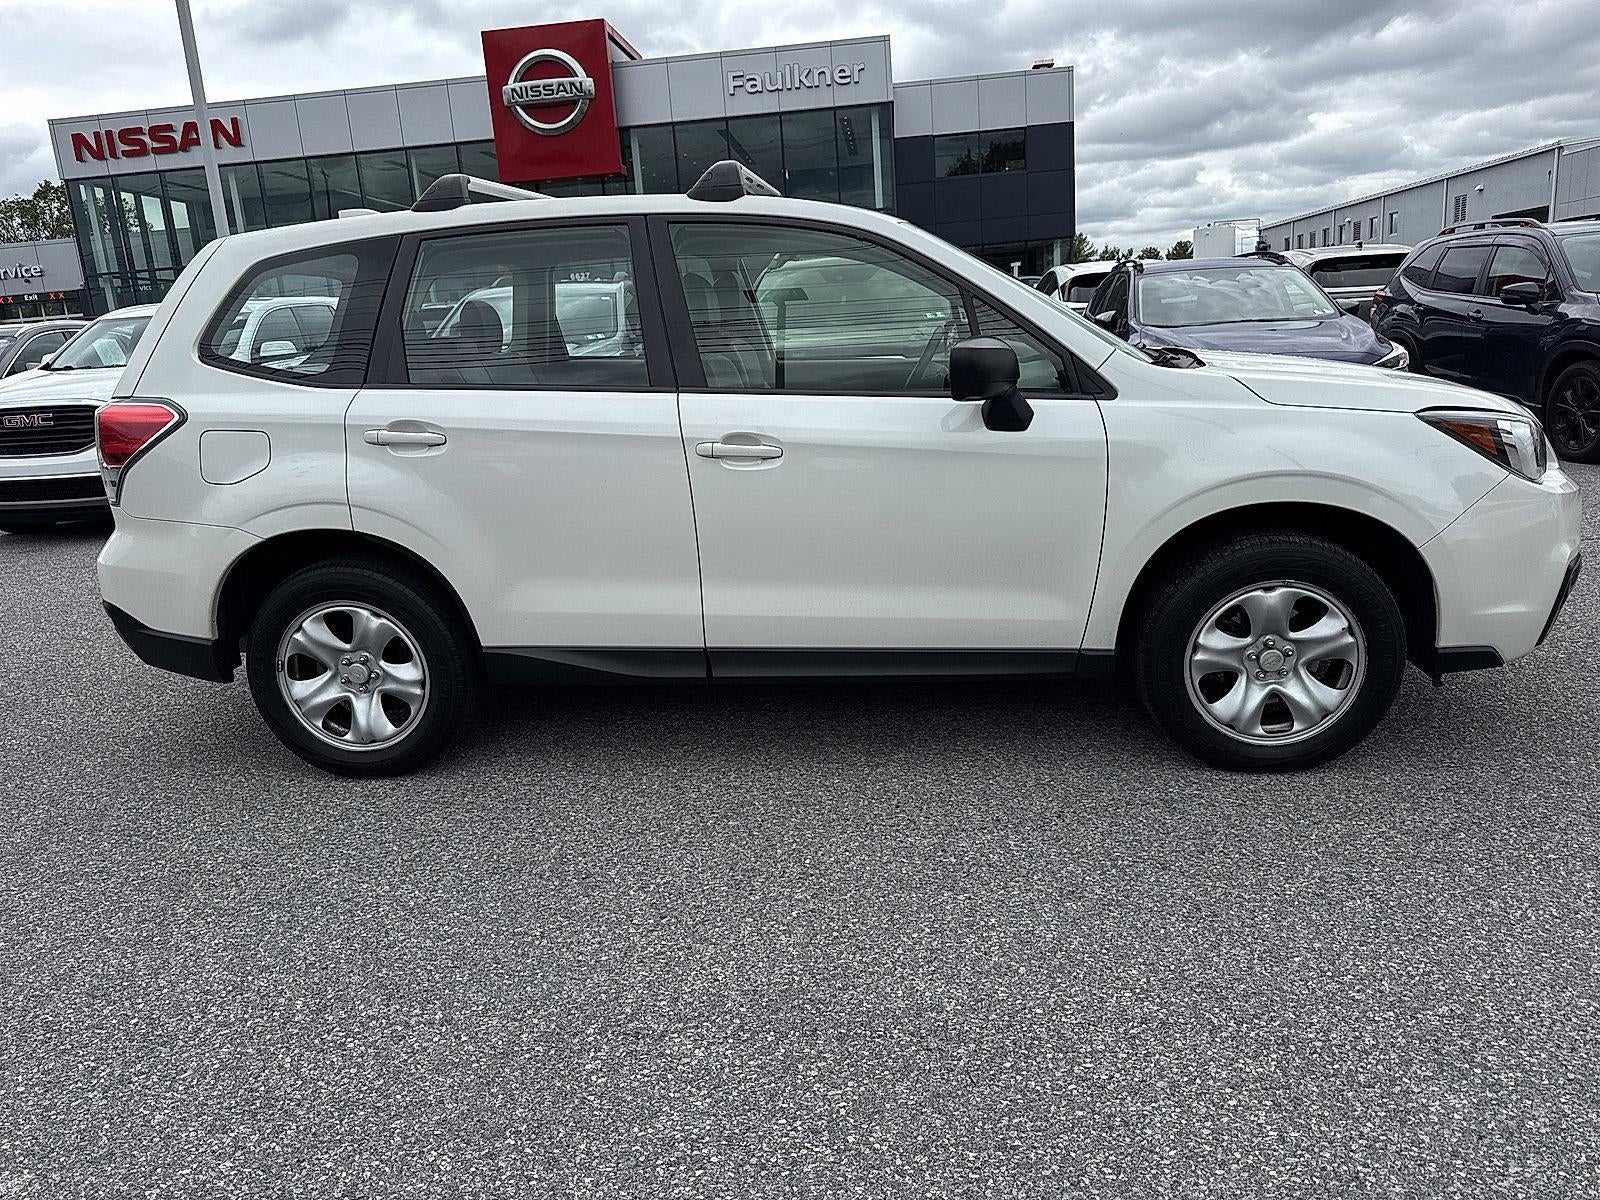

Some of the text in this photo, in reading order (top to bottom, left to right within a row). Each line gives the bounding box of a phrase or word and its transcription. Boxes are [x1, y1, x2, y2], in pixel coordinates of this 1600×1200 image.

[510, 81, 585, 101] NISSAN
[726, 62, 865, 96] Faulkner
[71, 116, 245, 163] NISSAN
[3, 413, 54, 428] GMC
